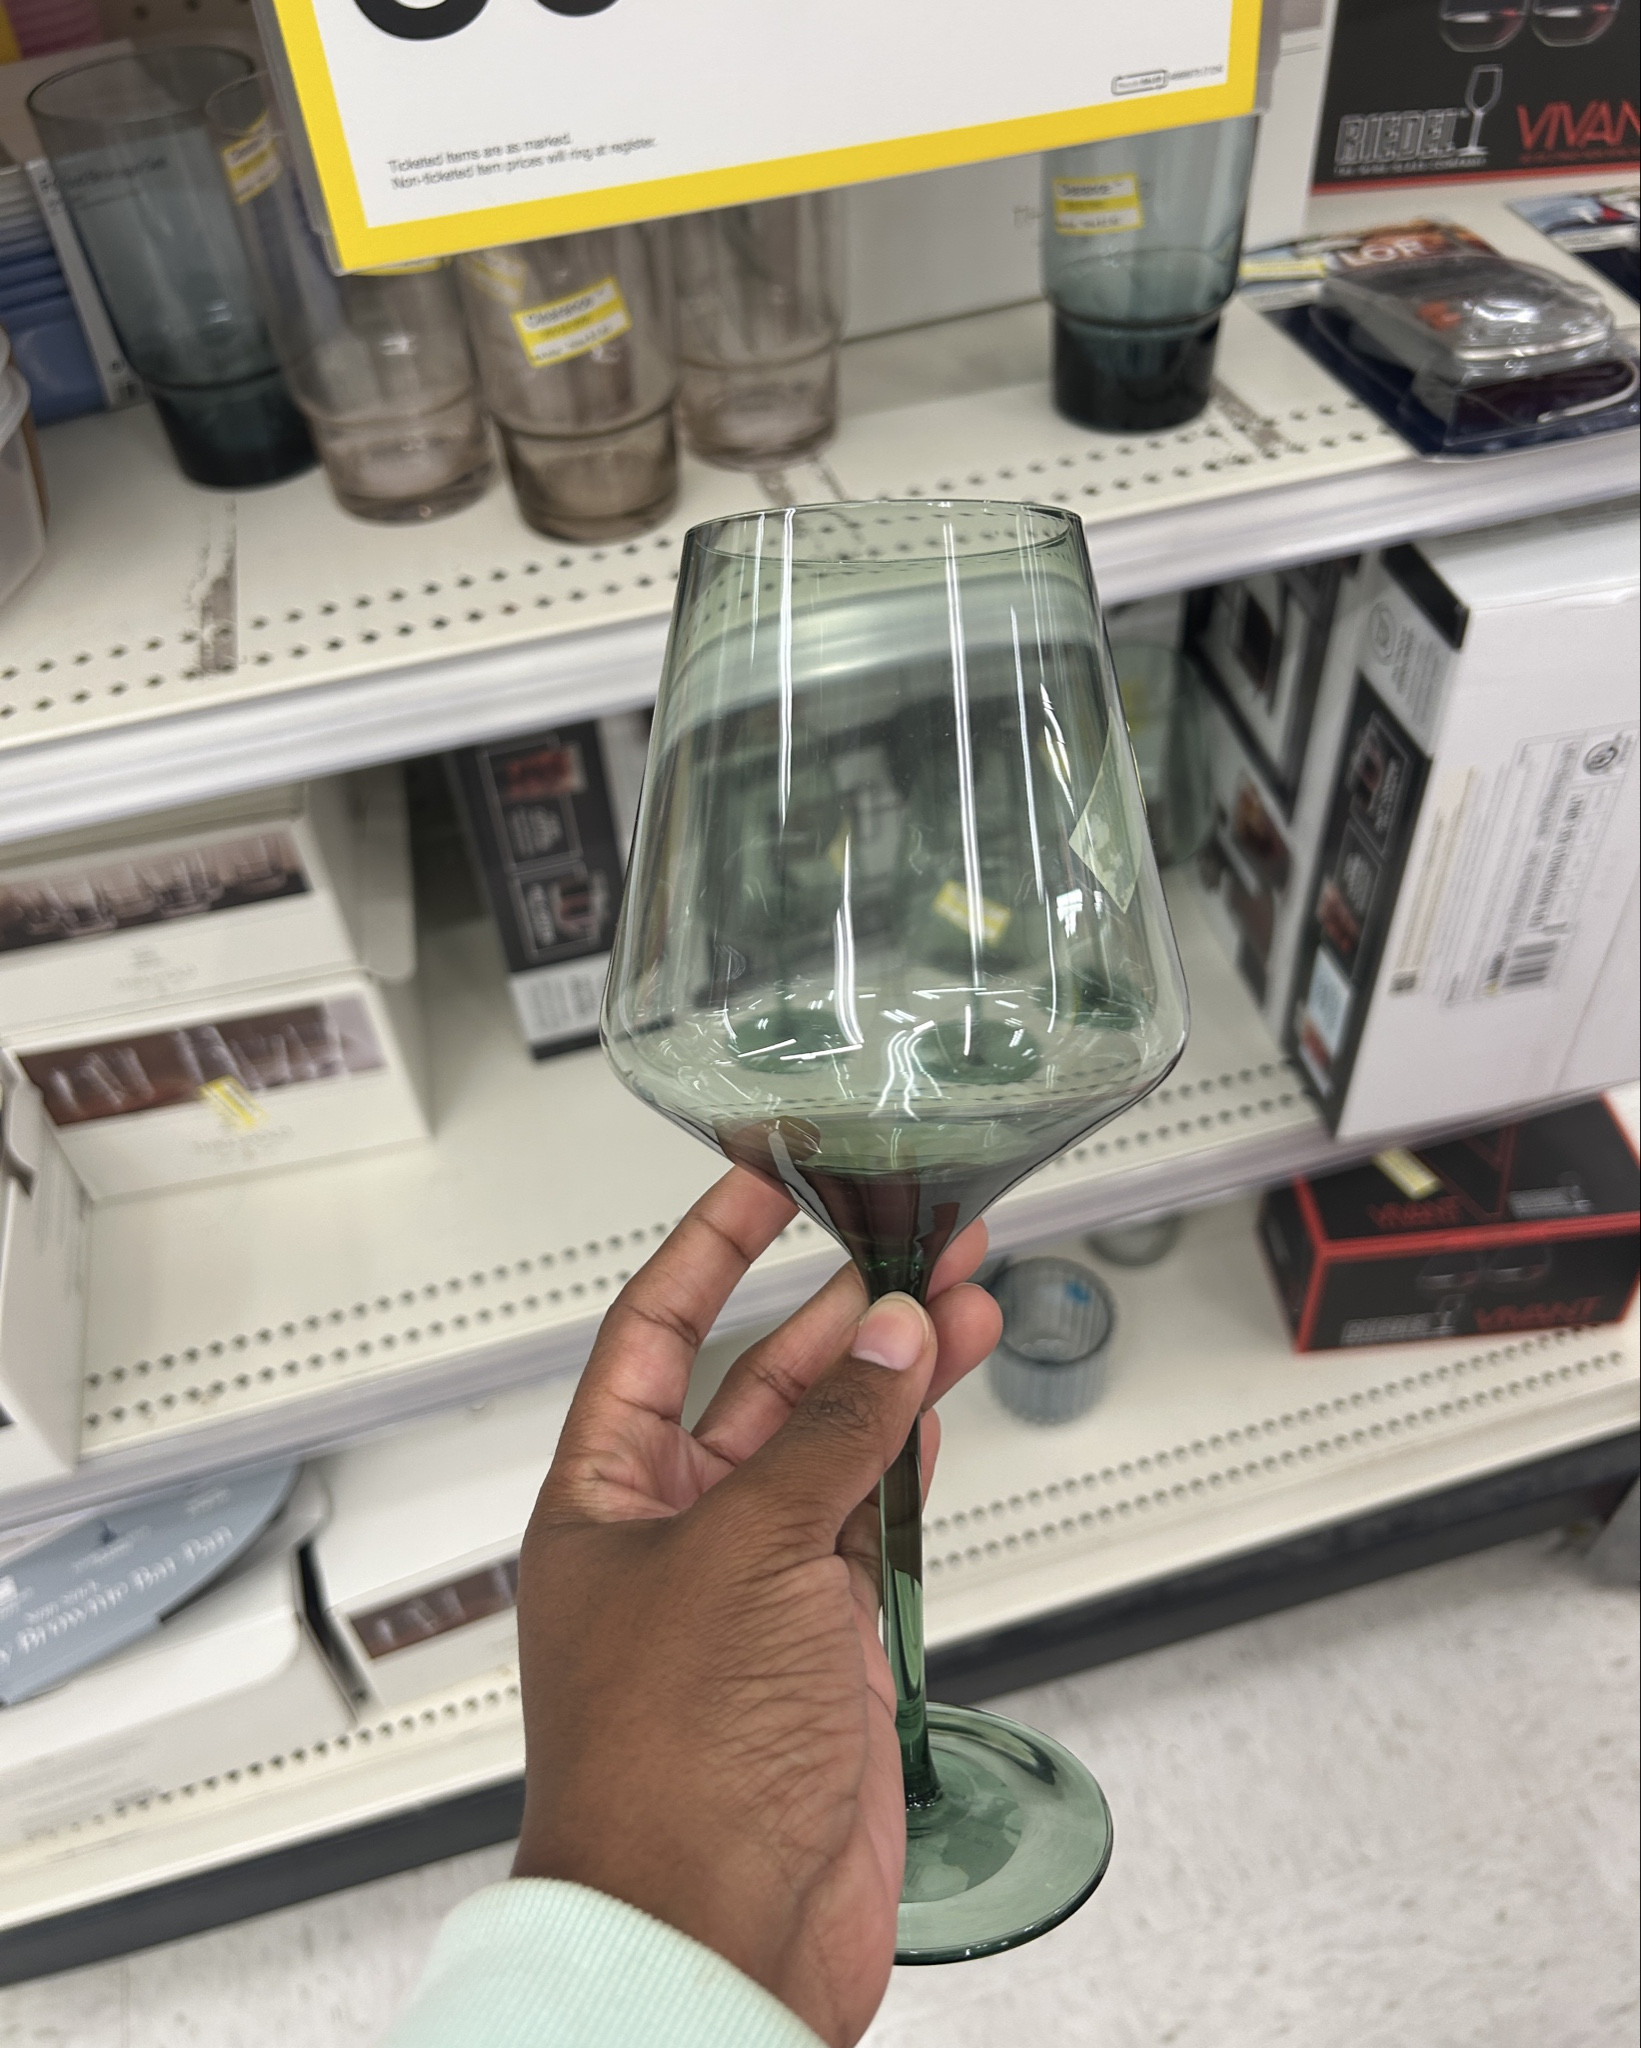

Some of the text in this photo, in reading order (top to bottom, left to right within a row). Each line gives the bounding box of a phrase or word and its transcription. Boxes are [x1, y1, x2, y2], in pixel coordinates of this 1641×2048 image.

[388, 153, 443, 172] Ticketed
[446, 150, 480, 164] items
[482, 145, 503, 158] are
[504, 142, 520, 155] as
[1335, 108, 1456, 165] RIEDEL
[391, 165, 475, 190] Non-ticketed
[505, 155, 545, 174] prices
[546, 149, 566, 165] will
[569, 148, 594, 162] ring
[596, 144, 606, 157] at
[16, 1580, 130, 1653] Brownie
[180, 1525, 233, 1565] Pan
